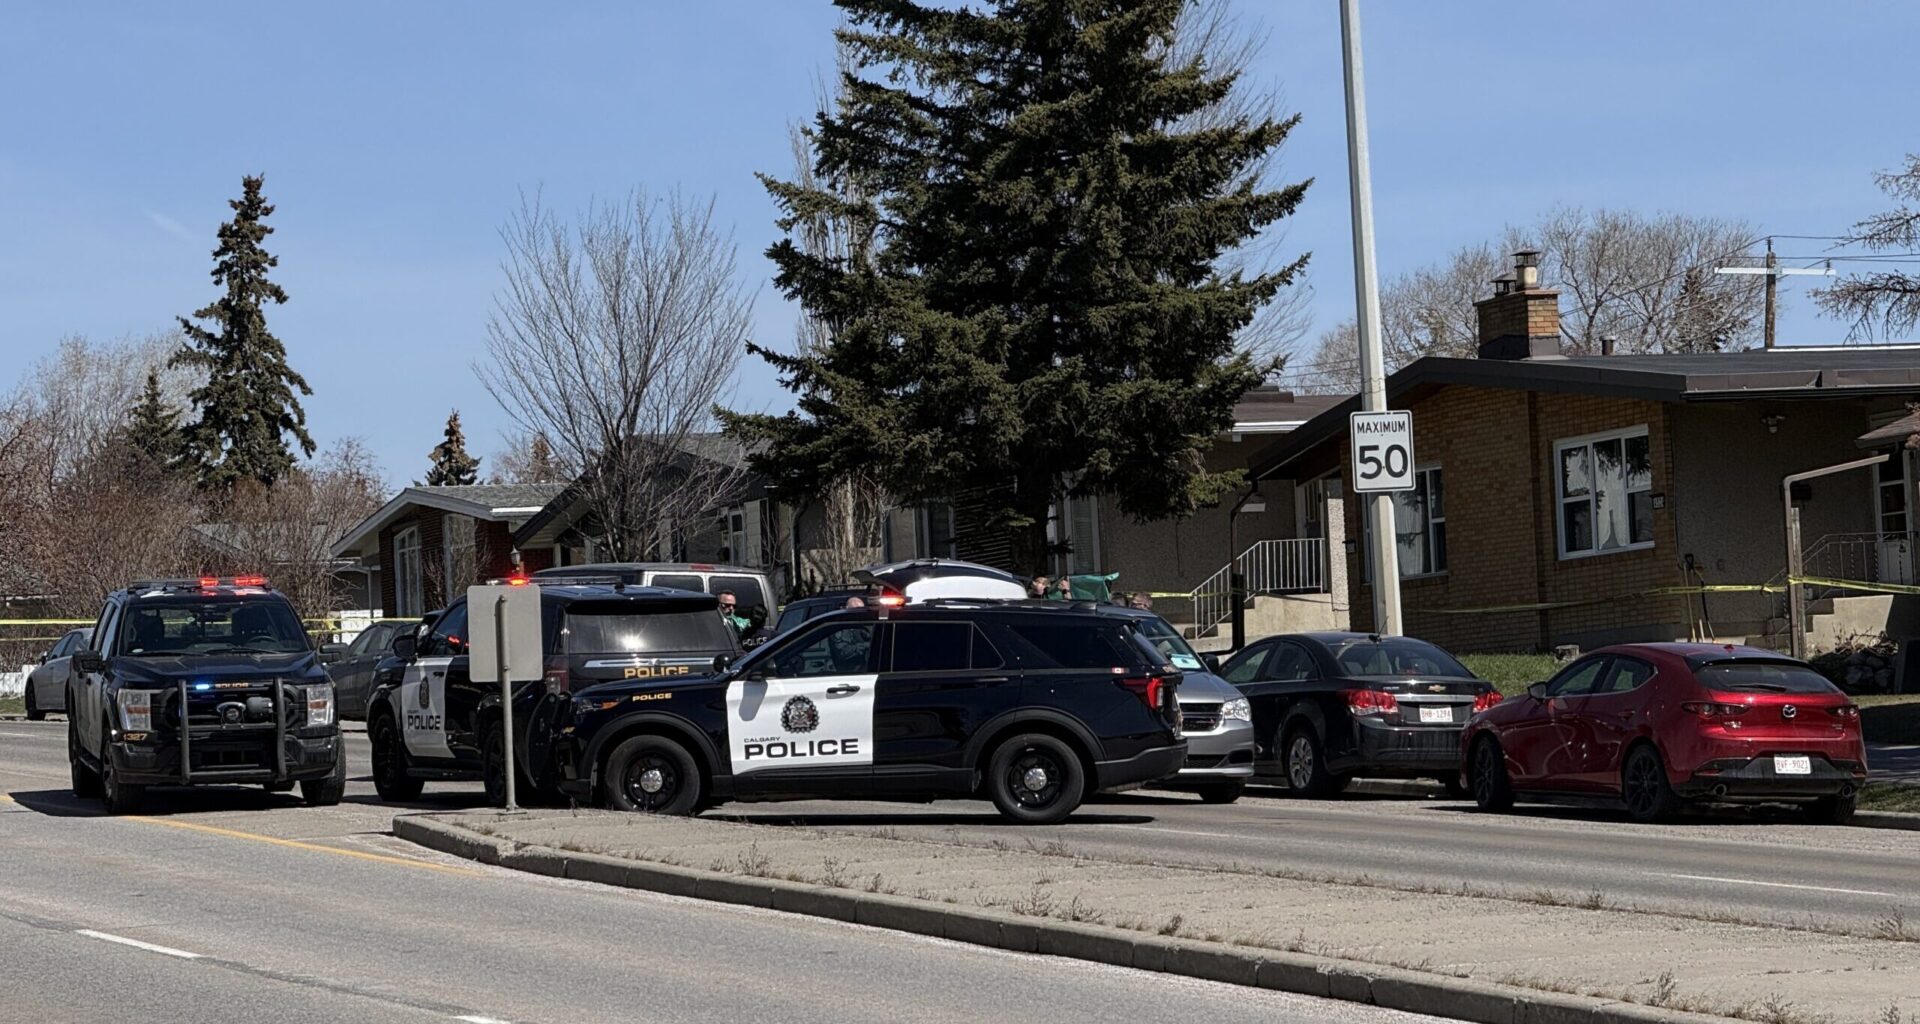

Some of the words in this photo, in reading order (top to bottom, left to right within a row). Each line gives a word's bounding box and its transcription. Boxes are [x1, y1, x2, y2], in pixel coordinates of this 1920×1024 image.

[1357, 420, 1406, 434] MAXIMUM
[1359, 444, 1408, 479] 50
[624, 666, 689, 679] POLICE
[632, 692, 673, 702] POLICE
[407, 715, 441, 730] POLICE
[744, 738, 859, 760] POLICE
